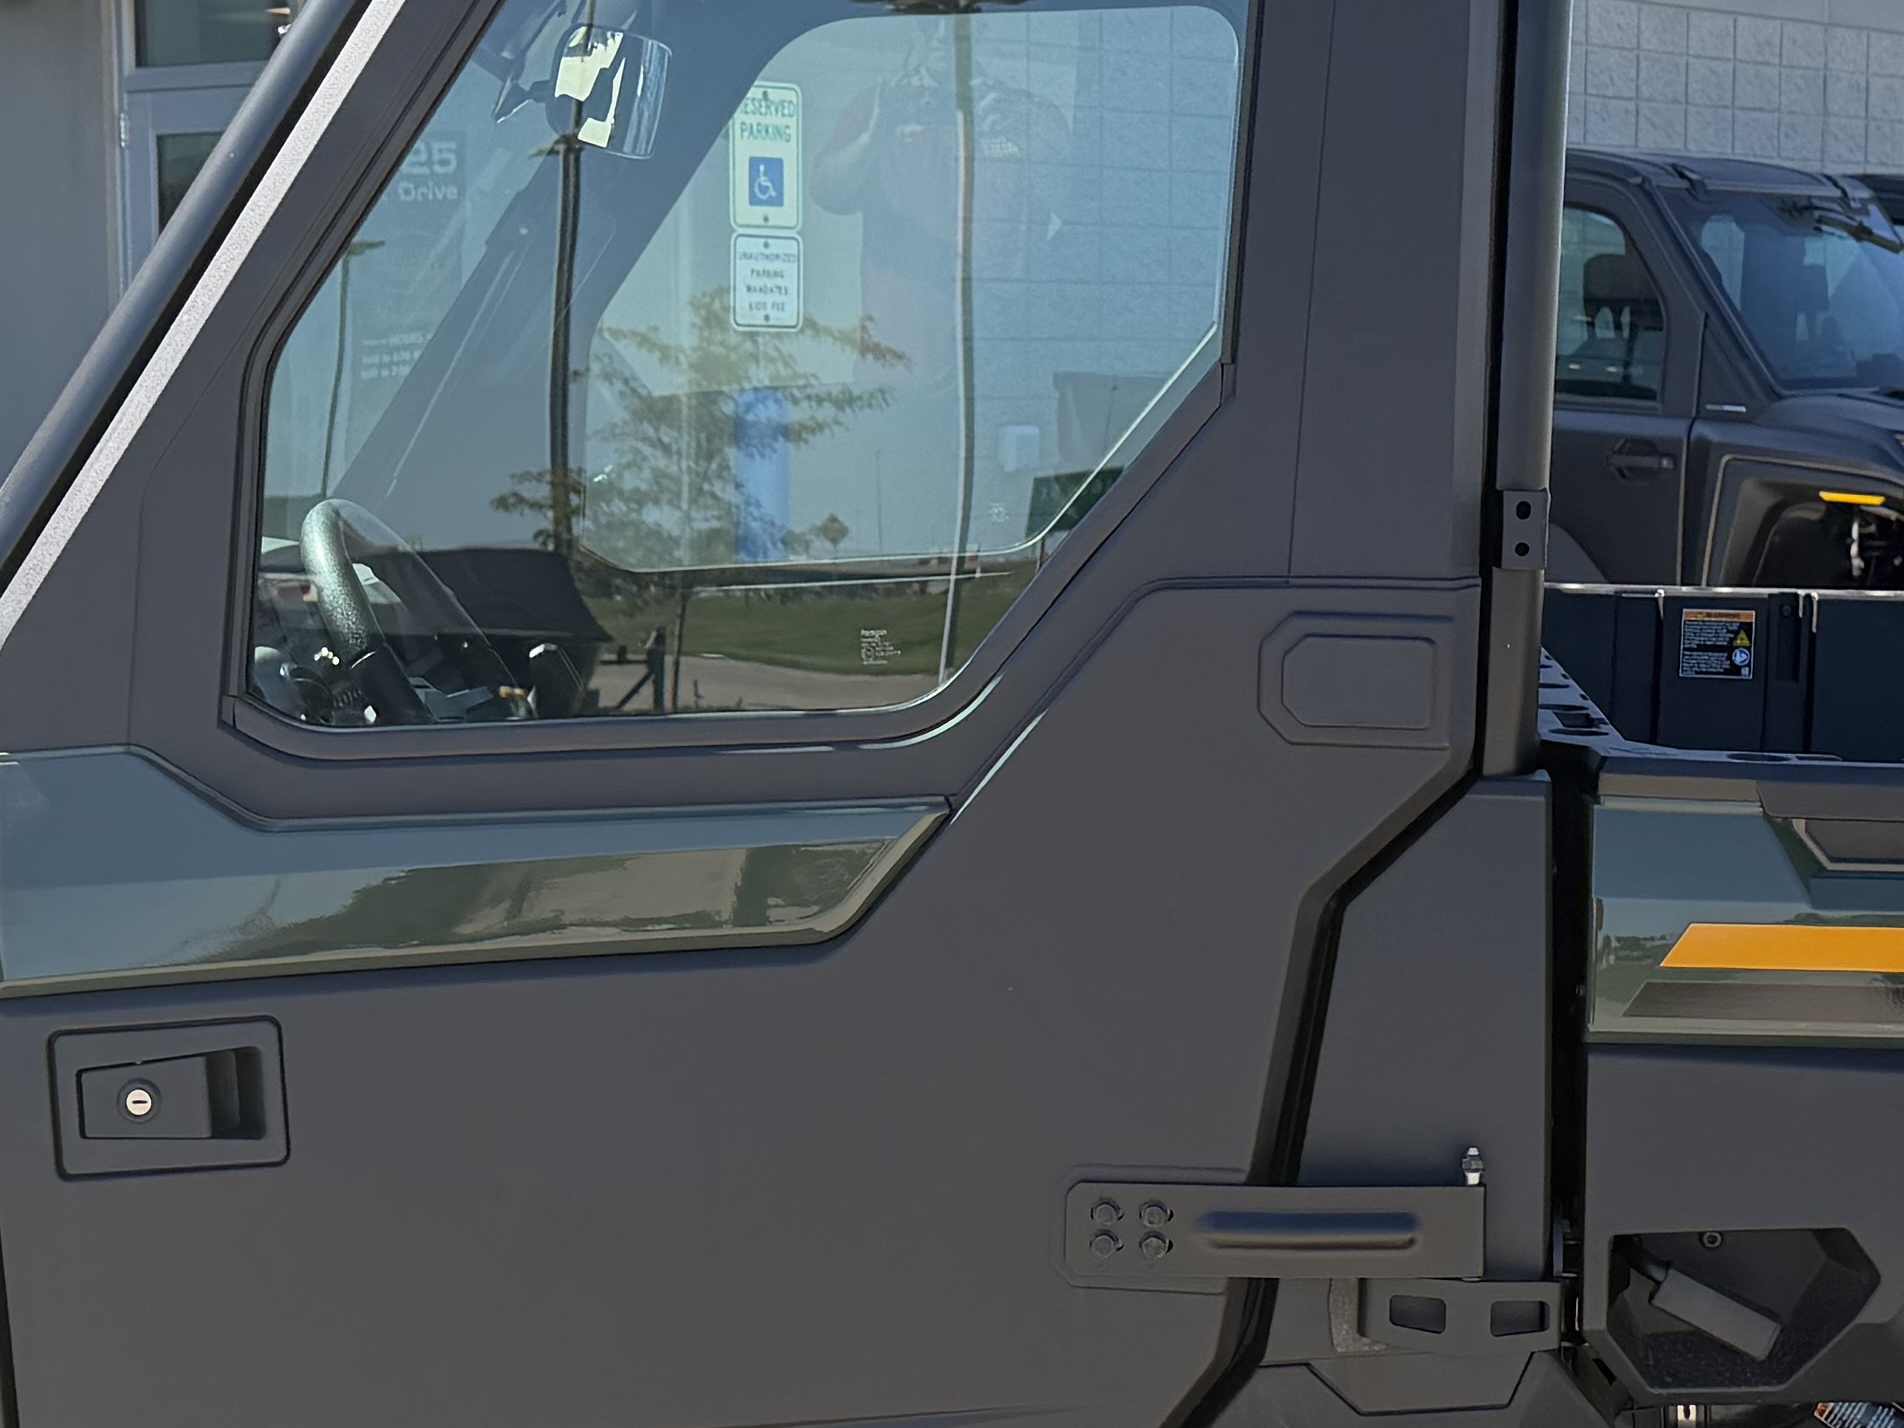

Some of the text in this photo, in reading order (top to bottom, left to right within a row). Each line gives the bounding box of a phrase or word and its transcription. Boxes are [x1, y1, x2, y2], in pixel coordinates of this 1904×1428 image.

[740, 96, 797, 118] ESERVED
[740, 121, 792, 143] PARKING
[398, 182, 458, 201] Drive
